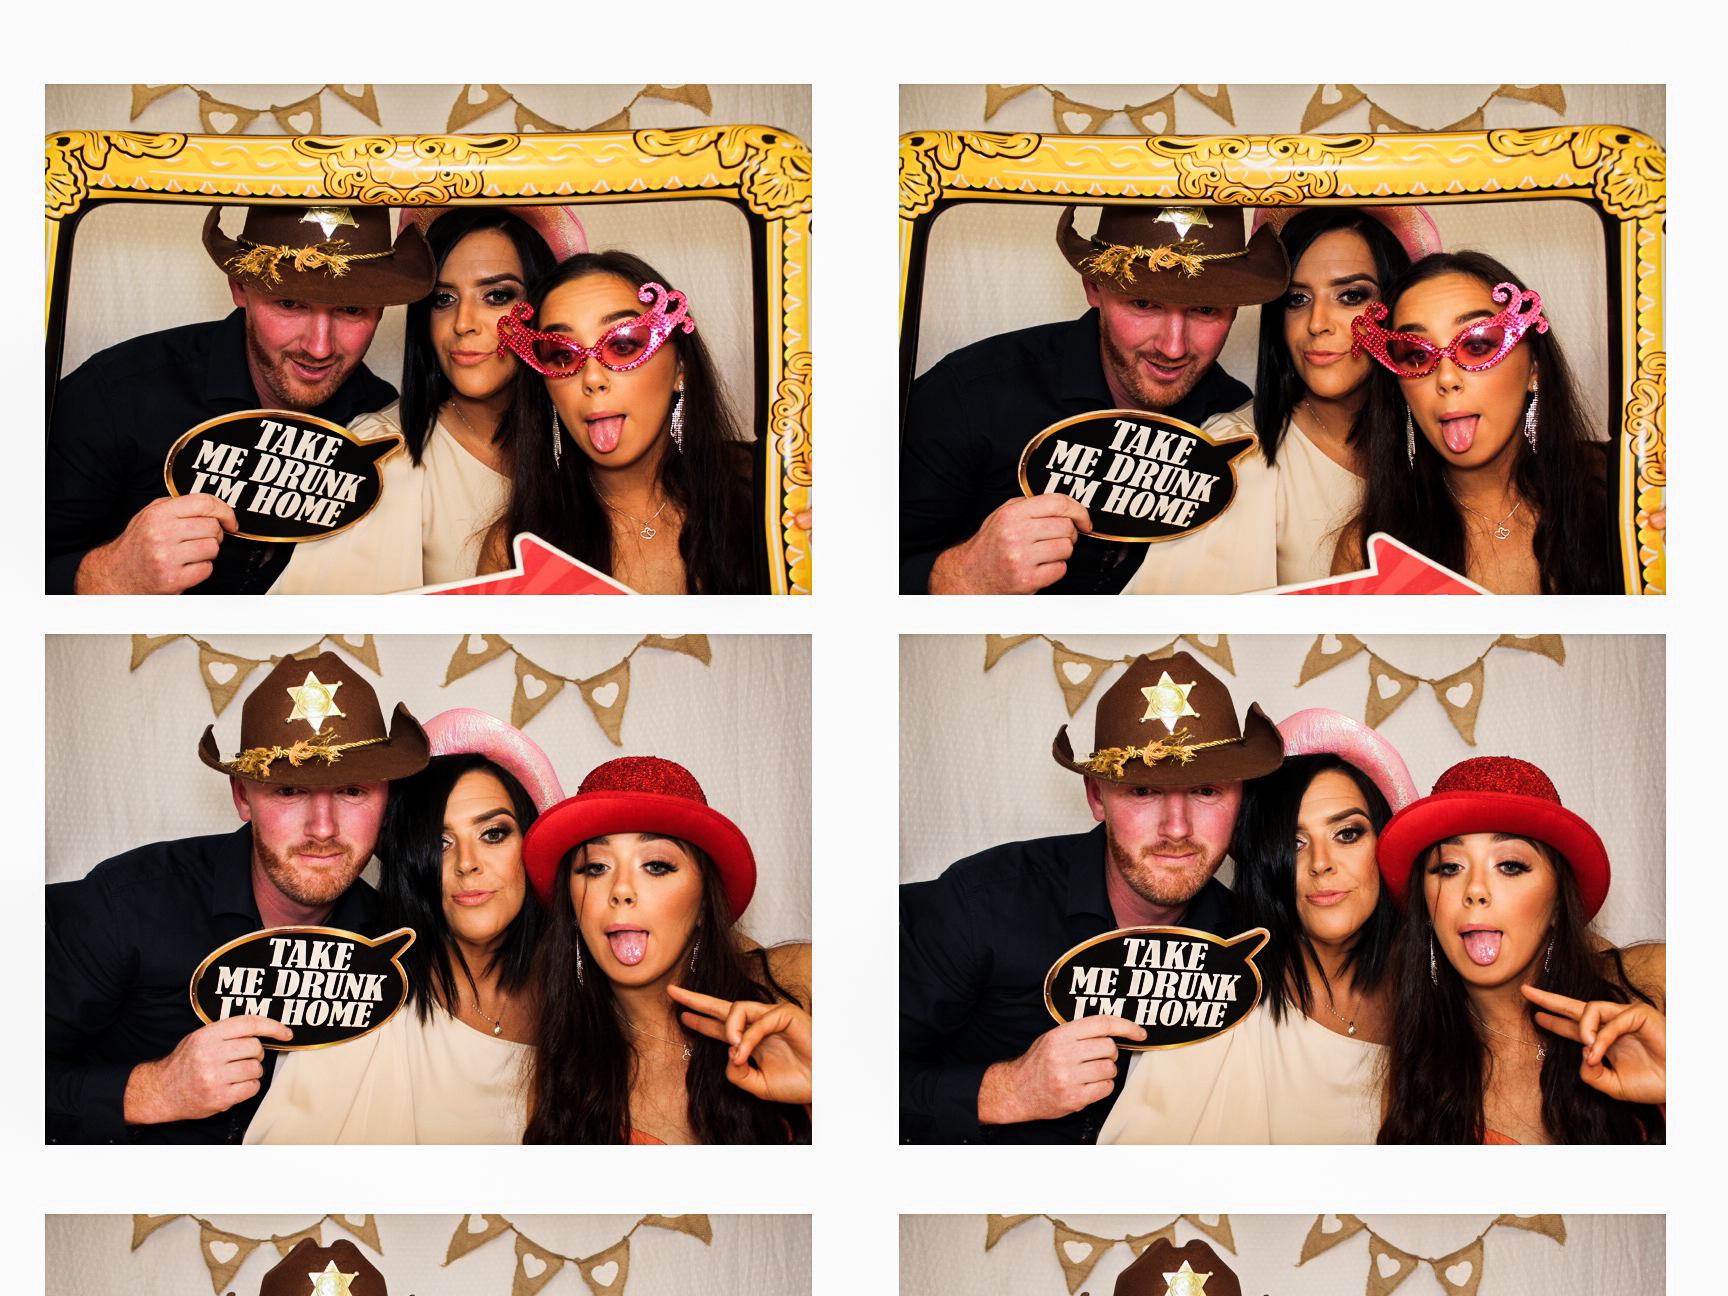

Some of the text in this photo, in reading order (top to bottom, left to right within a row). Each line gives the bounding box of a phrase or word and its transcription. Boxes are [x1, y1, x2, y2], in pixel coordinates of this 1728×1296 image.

[254, 419, 343, 467] TAKE
[1108, 419, 1197, 467] TAKE
[191, 439, 366, 503] ME DRUNK
[1045, 439, 1220, 503] ME DRUNK
[246, 484, 346, 528] HOME
[1100, 484, 1200, 528] HOME
[269, 937, 355, 971] TAKE
[1123, 937, 1209, 971] TAKE
[214, 966, 388, 1002] ME DRUNK
[1068, 966, 1242, 1002] ME DRUNK
[279, 998, 374, 1028] HOME
[1133, 998, 1228, 1028] HOME
